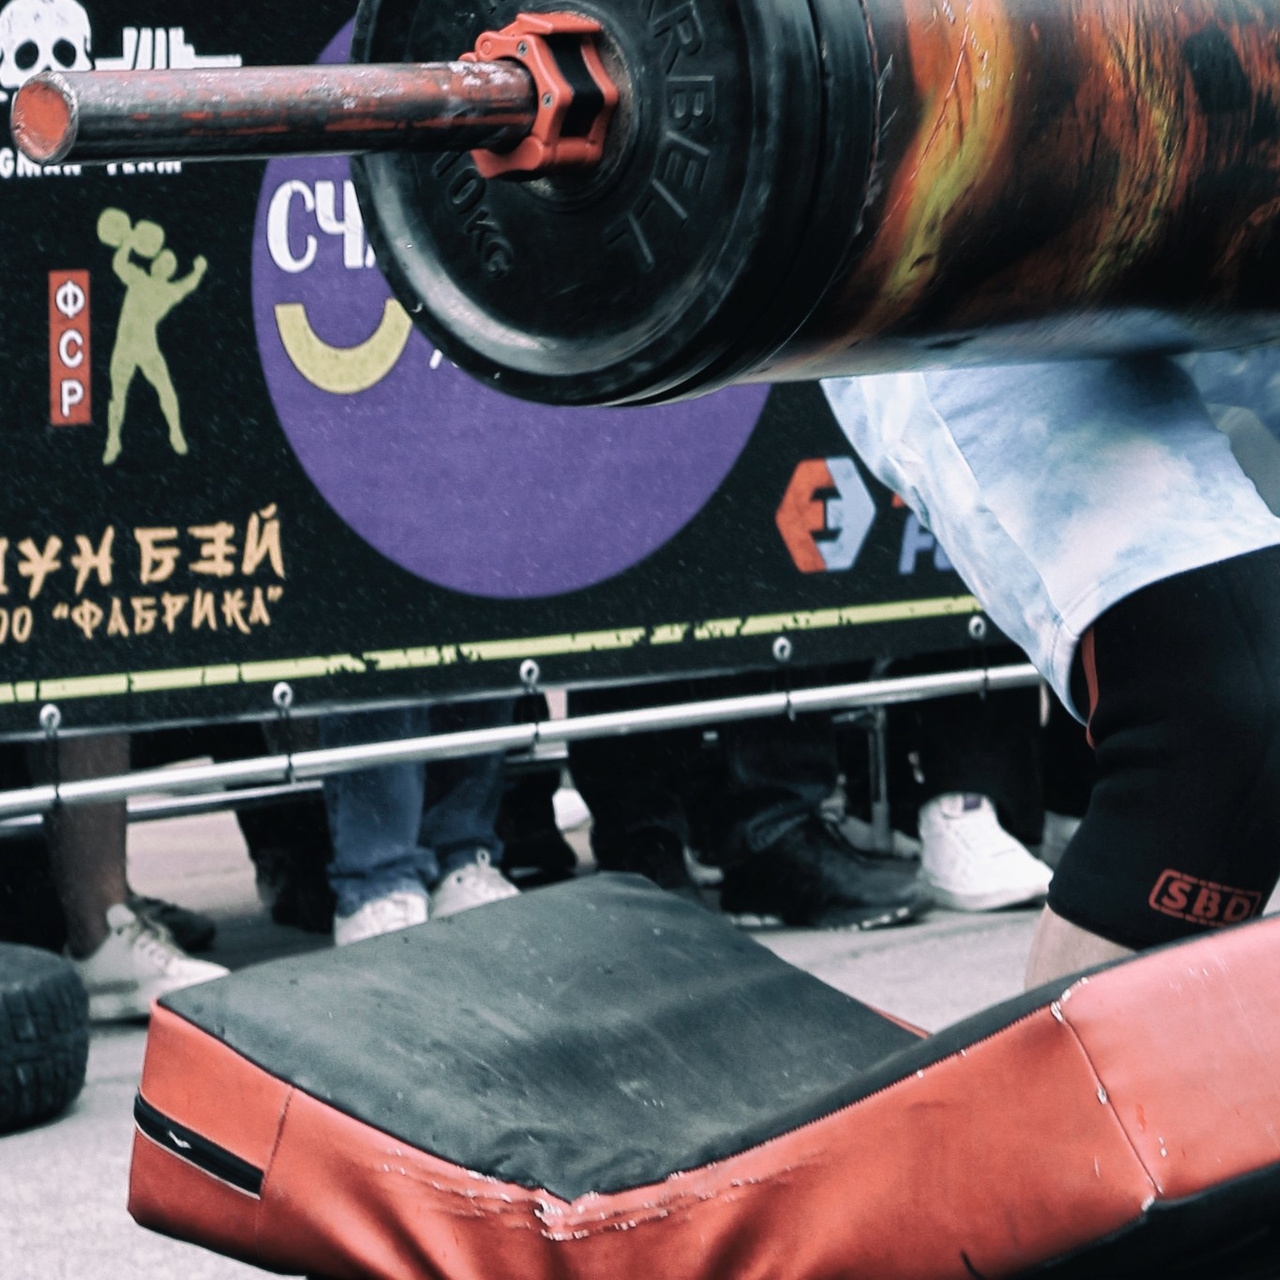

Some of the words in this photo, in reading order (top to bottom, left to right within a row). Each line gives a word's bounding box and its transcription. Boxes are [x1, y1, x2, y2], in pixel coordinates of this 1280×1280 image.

[266, 179, 376, 273] СЧ
[0, 525, 115, 600] УН
[1160, 879, 1252, 923] SBD
